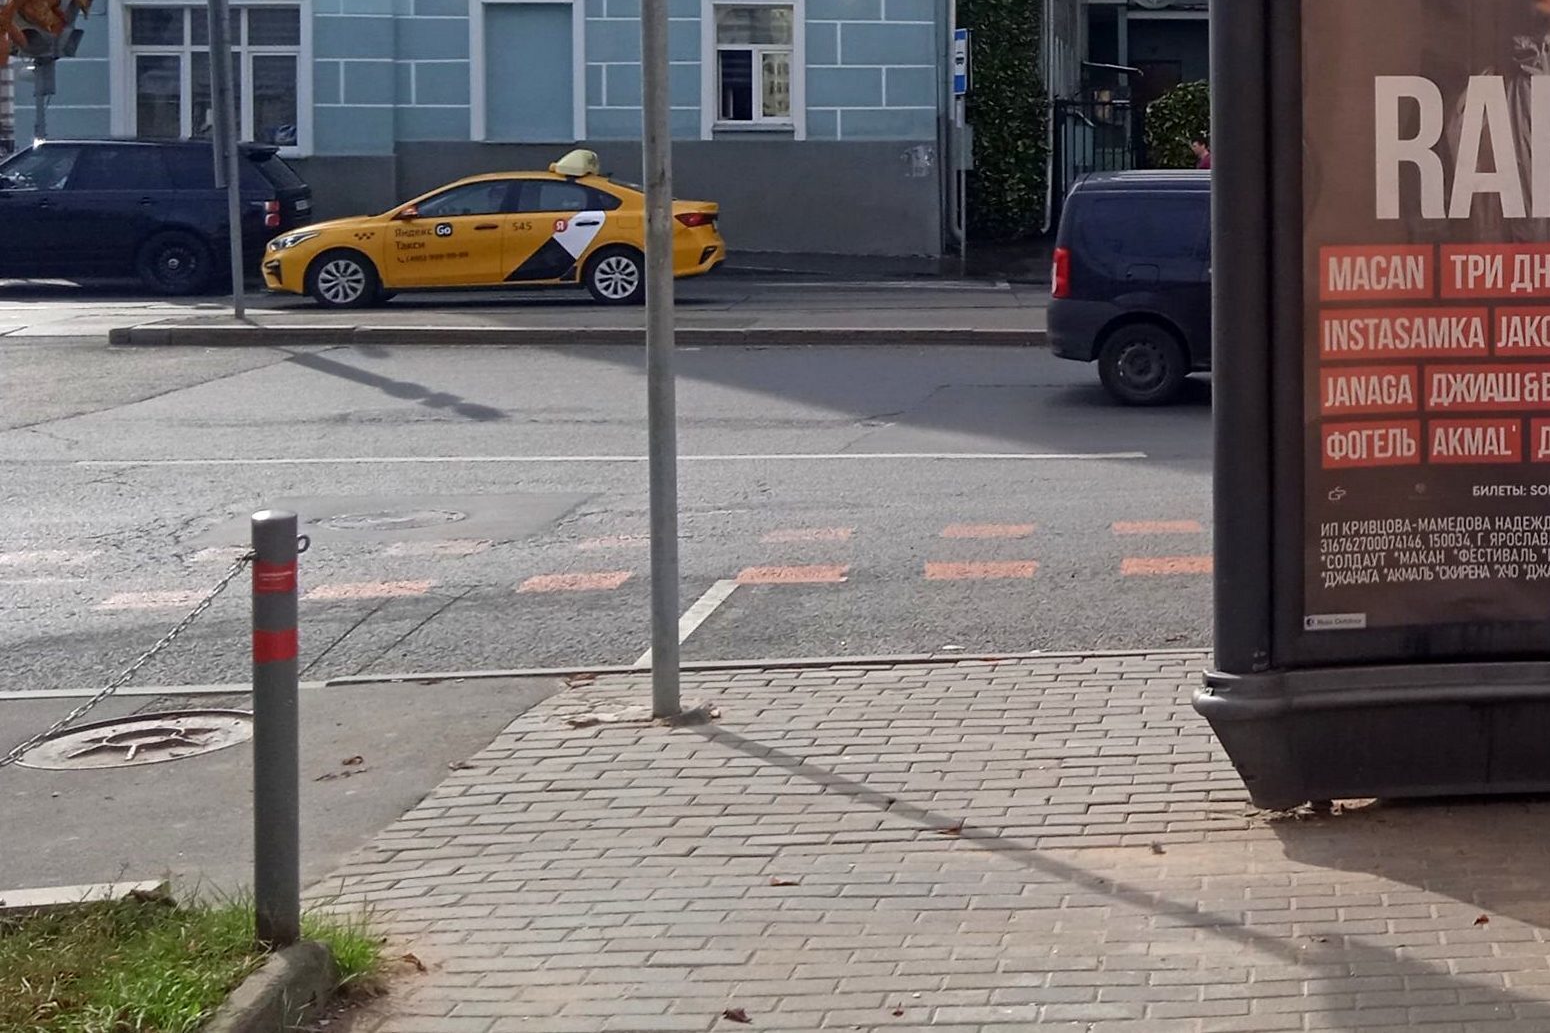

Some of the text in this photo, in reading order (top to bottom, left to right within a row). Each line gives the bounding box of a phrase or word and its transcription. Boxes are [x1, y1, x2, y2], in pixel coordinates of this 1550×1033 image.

[395, 225, 451, 239] Яндекс Go
[512, 222, 533, 231] 545
[396, 240, 426, 250] Такси
[1328, 256, 1424, 291] MACAN
[1451, 255, 1502, 289] ТРИ
[1324, 317, 1485, 351] INSTASAMKA
[1325, 374, 1413, 407] JANAGA
[1430, 373, 1520, 406] ДЖИАШ
[1326, 428, 1416, 460] ФОГЕЛЬ
[1433, 425, 1517, 456] AKMAL'
[1473, 485, 1527, 496] БИЛЕТЫ:
[1321, 522, 1338, 537] ИП
[1342, 516, 1491, 536] КРИВЦОВА-МАМЕДОВА
